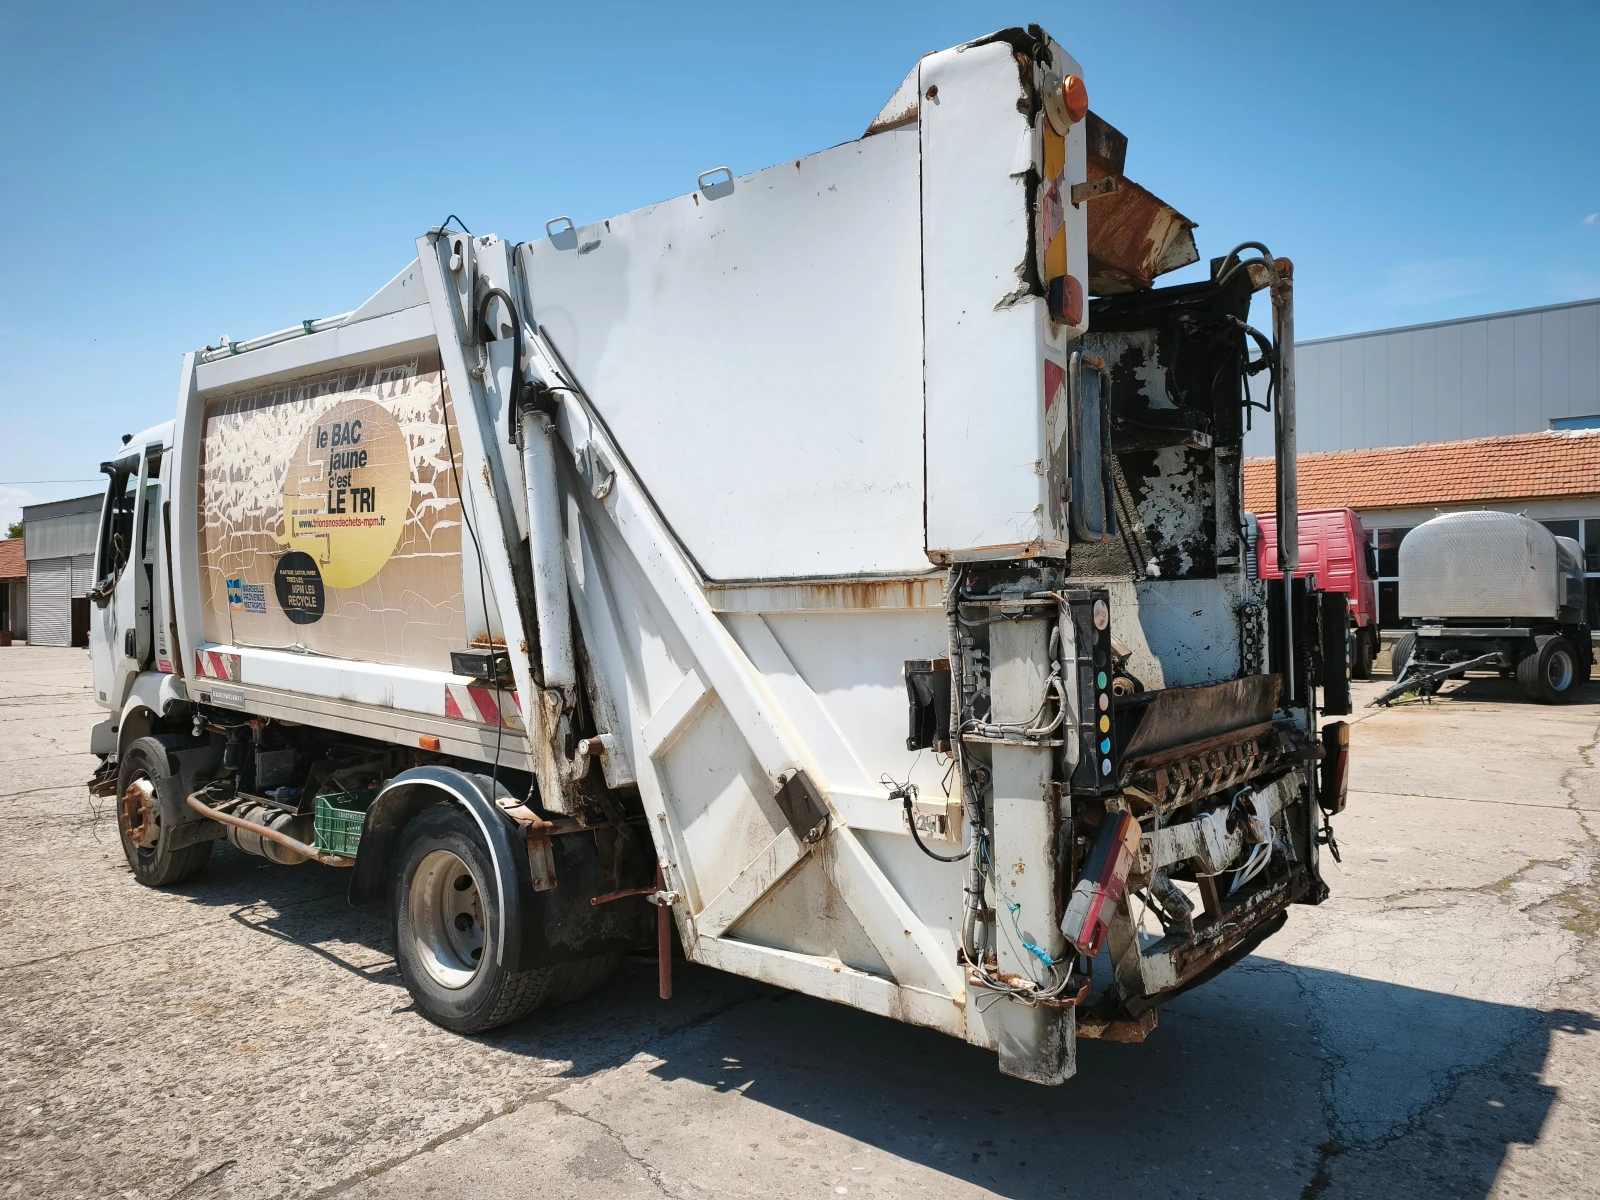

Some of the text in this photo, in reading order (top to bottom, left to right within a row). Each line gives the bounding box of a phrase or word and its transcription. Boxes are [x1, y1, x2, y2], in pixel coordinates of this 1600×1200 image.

[316, 420, 361, 448] le BAC
[328, 448, 367, 476] jaune
[328, 471, 351, 488] c'est
[327, 487, 375, 514] LE TRI
[288, 595, 317, 607] RECYCLE
[305, 585, 315, 595] LES
